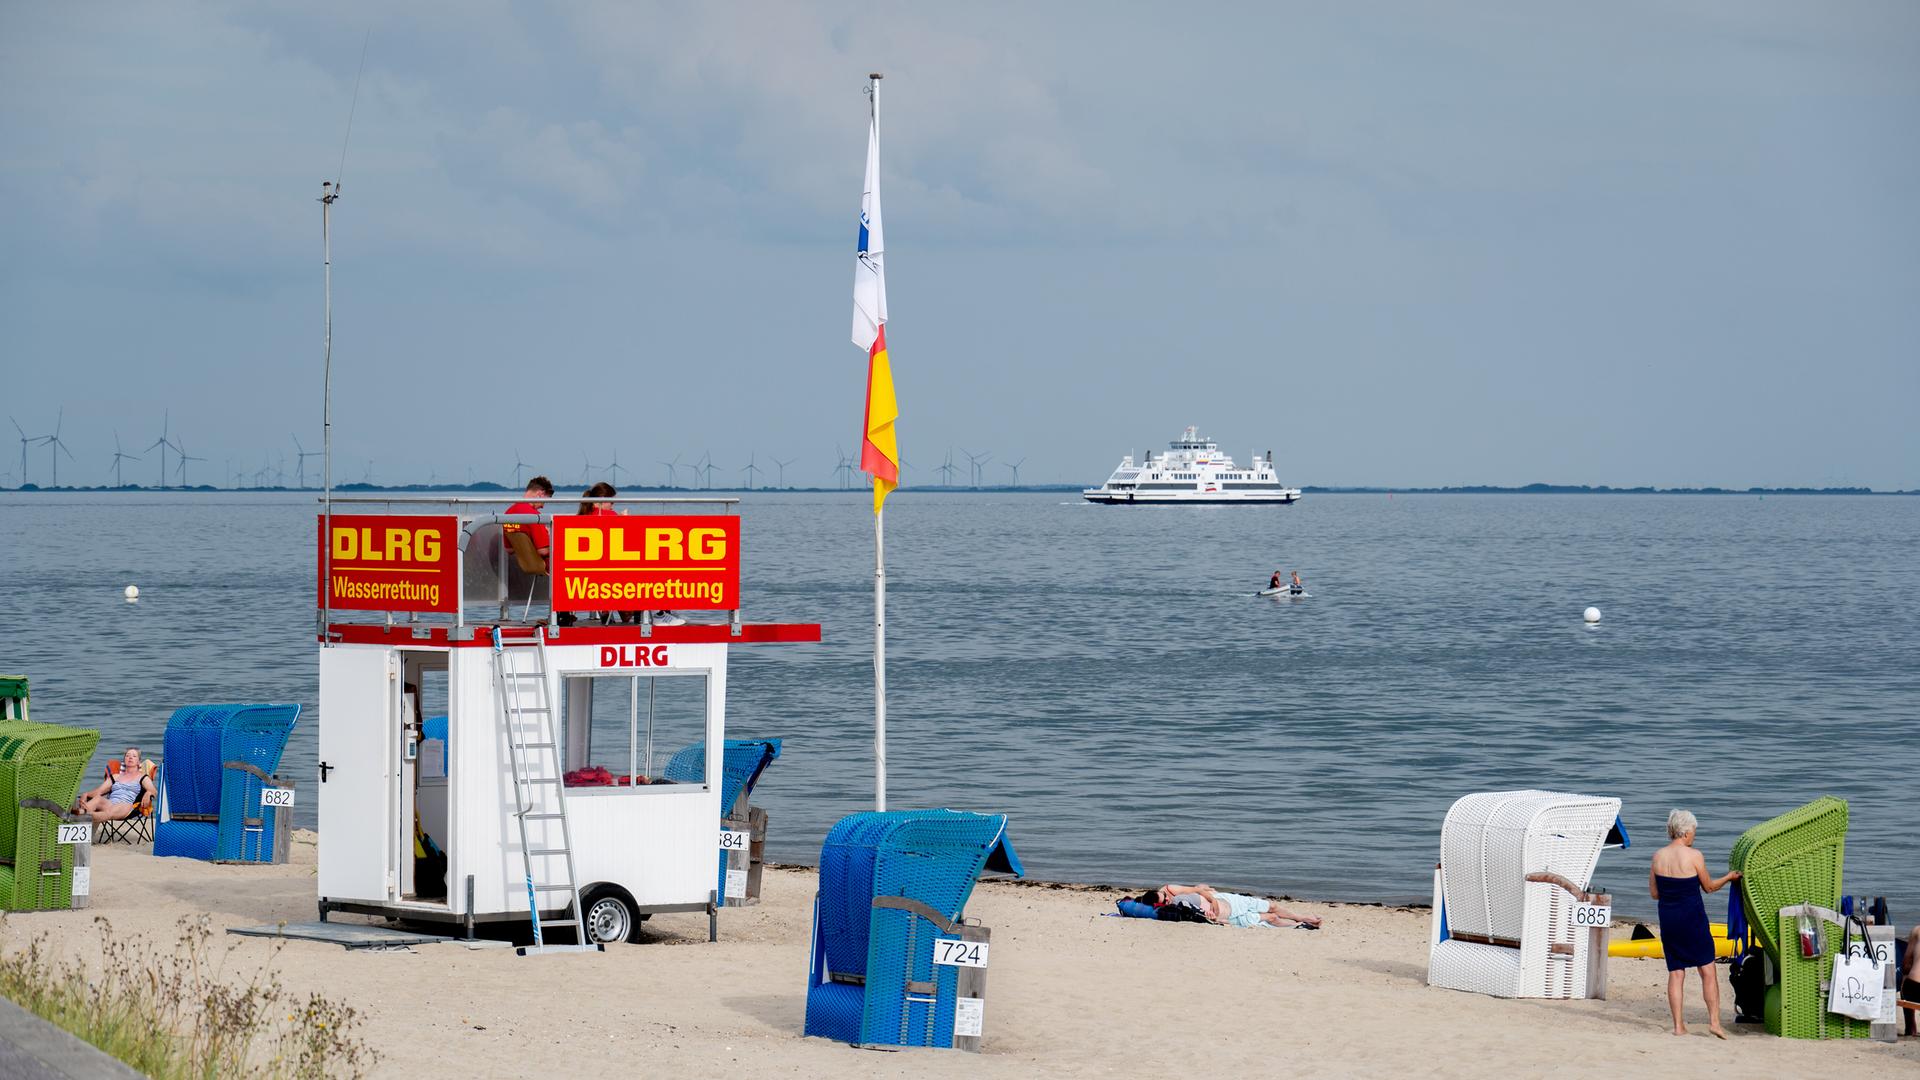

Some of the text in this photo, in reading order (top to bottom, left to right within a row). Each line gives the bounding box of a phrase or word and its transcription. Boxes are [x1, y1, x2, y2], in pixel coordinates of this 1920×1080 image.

[332, 527, 441, 562] DLRG
[564, 527, 727, 561] DLRG
[332, 575, 439, 606] Wasserrettung
[564, 576, 724, 604] Wasserrettung
[600, 645, 669, 667] DLRG
[265, 790, 290, 805] 682
[63, 826, 87, 841] 723
[1576, 906, 1606, 925] 685
[942, 942, 980, 964] 724
